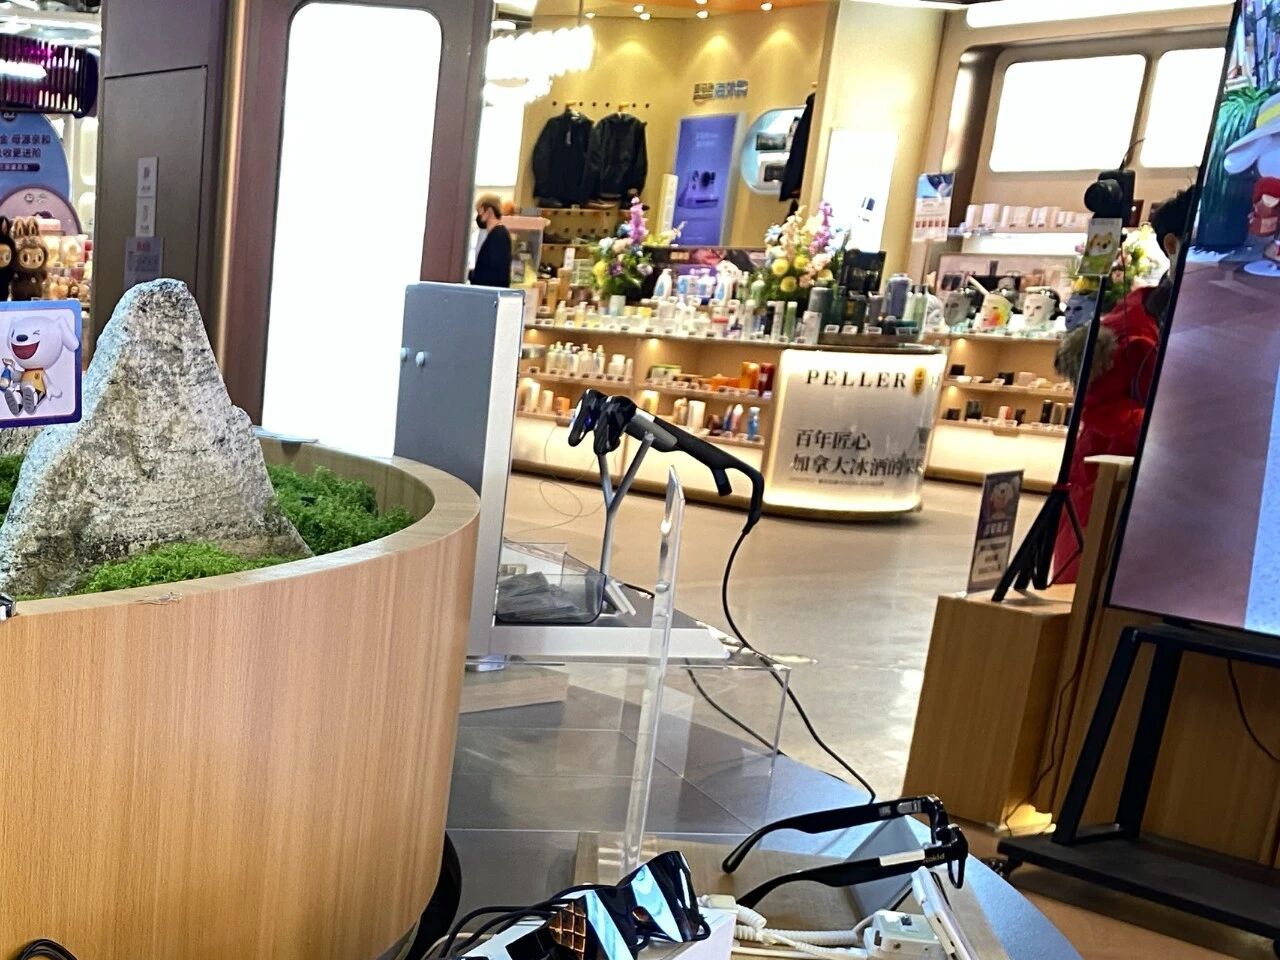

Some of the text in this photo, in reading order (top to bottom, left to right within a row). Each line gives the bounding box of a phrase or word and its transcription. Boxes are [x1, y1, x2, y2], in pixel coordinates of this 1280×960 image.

[806, 369, 907, 388] PELLER
[795, 429, 871, 450] 百年匠心
